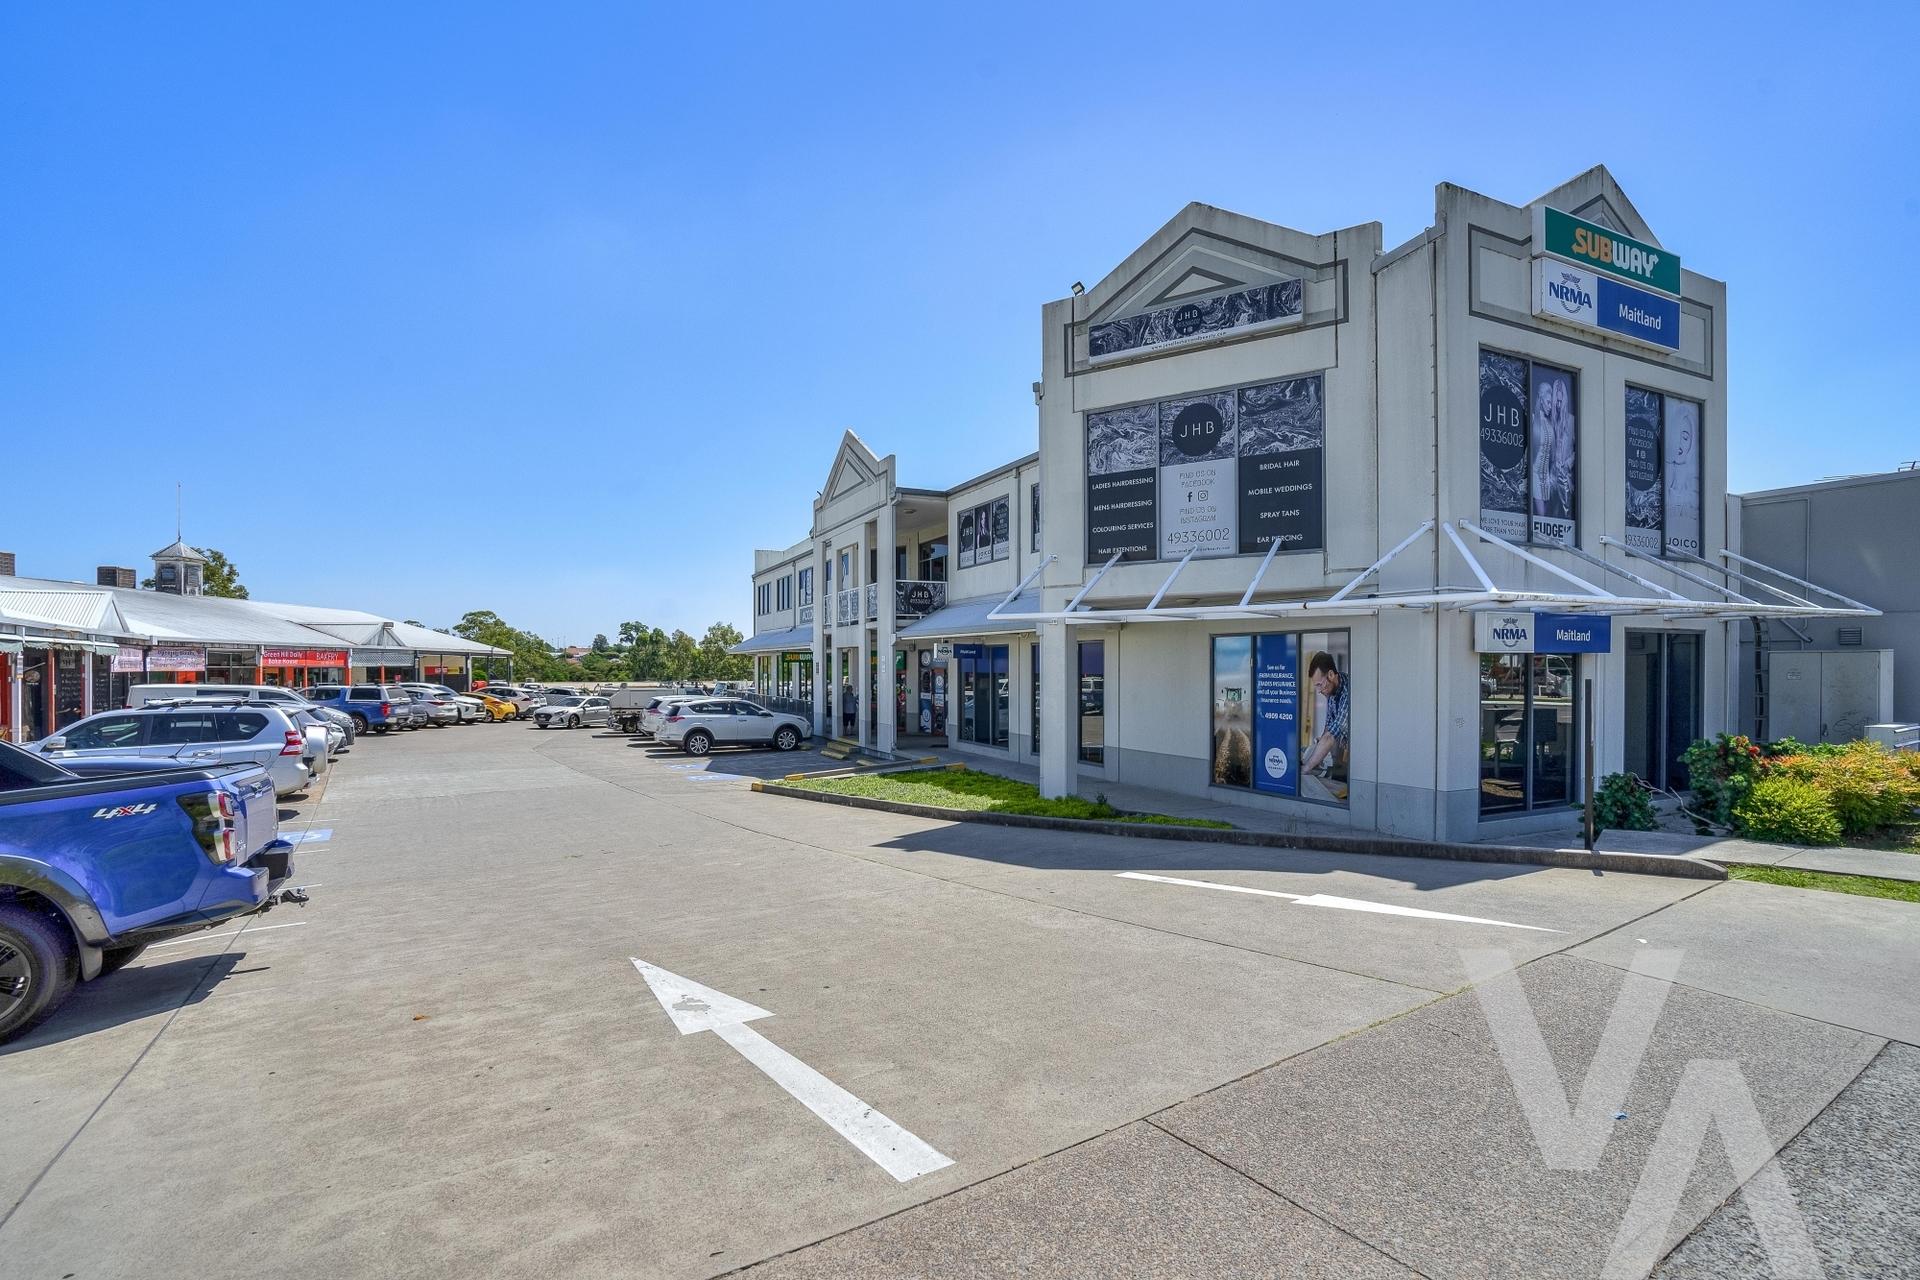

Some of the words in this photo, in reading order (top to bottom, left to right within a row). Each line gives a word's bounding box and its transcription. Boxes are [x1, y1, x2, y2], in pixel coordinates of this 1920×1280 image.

[1571, 227, 1660, 279] SUBWAY
[1549, 281, 1593, 309] NRMA
[1619, 303, 1662, 330] Maitland
[1480, 427, 1524, 447] 49336002
[1260, 462, 1282, 471] BRIDAL
[1092, 479, 1111, 490] LADIES
[1112, 477, 1154, 488] HAIRDRESSING
[1248, 487, 1273, 496] MOBILE
[1274, 483, 1313, 493] WEDDINGS
[1111, 499, 1153, 510] HAIRDRESSING
[1260, 511, 1280, 519] SPRAY
[1281, 509, 1300, 517] TANS
[1092, 524, 1127, 534] COLOURING
[1128, 521, 1154, 530] SERVICES
[1534, 521, 1564, 538] FUDGE
[1168, 527, 1230, 544] 49336002
[1665, 537, 1697, 549] JOICO
[1493, 628, 1528, 640] NRMA
[1556, 629, 1591, 641] Maitland
[316, 652, 339, 661] BAKERY
[1279, 712, 1293, 720] 4200
